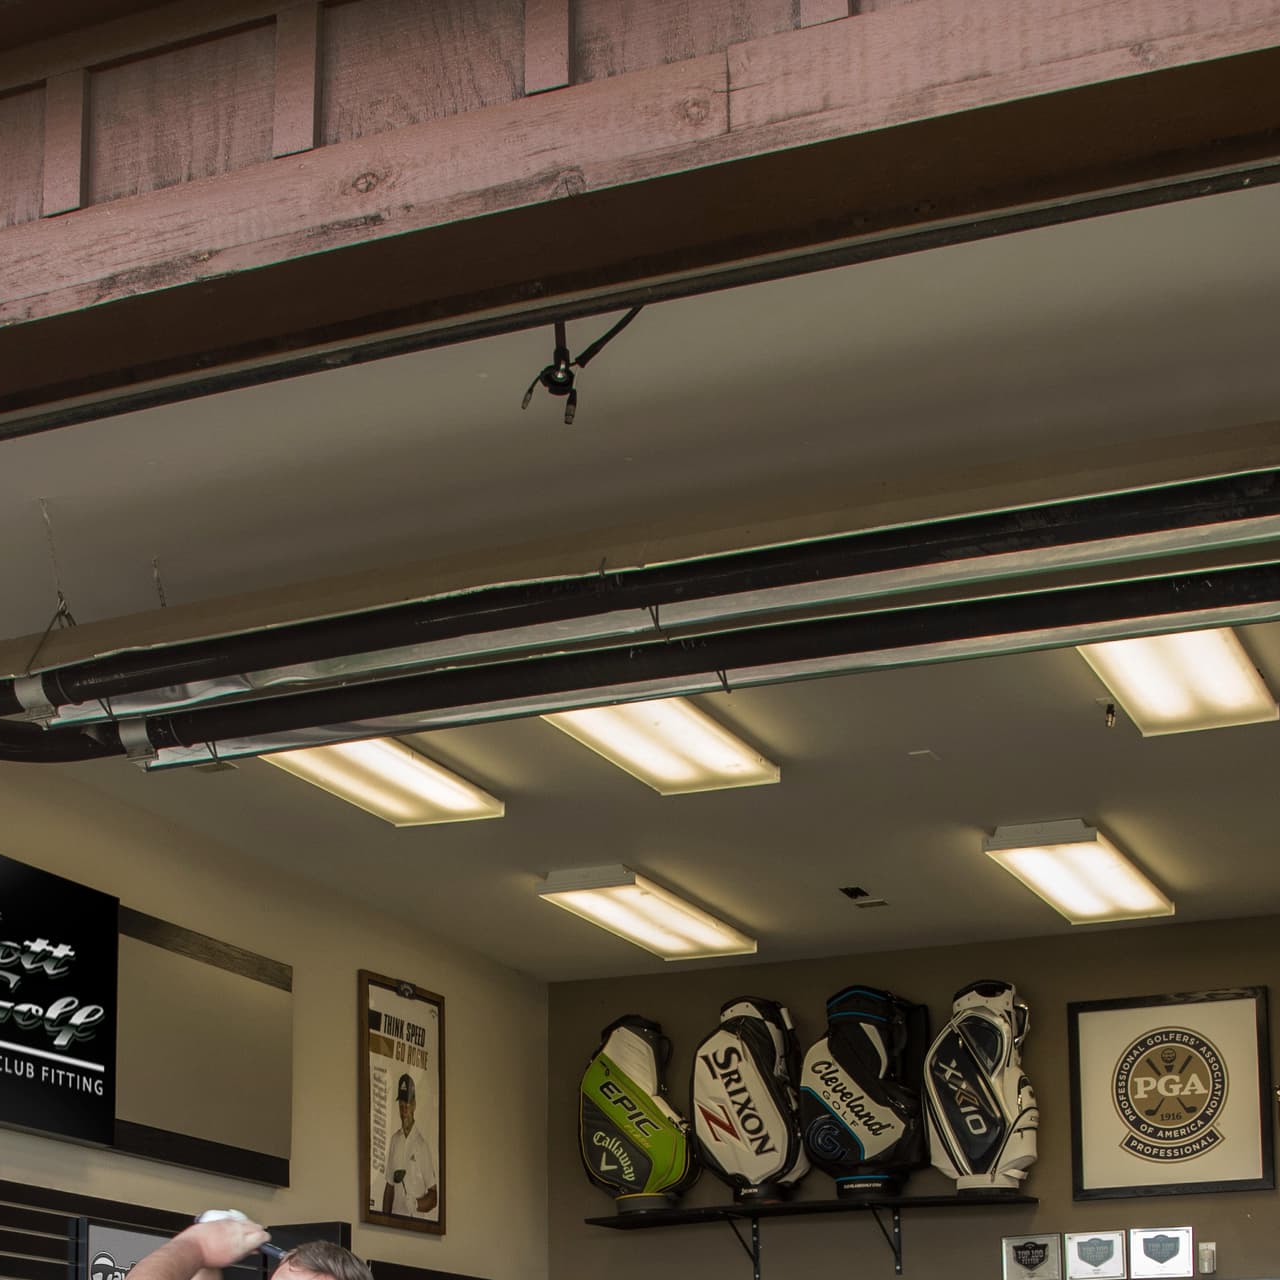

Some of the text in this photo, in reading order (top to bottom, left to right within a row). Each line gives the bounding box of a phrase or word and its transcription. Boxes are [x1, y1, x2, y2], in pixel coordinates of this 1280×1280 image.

[383, 1012, 426, 1049] THINK SPEED
[395, 1040, 429, 1072] GO ROGUE
[41, 1065, 104, 1096] FITTING
[1118, 1032, 1223, 1123] PROFESSIONAL GOLFERS' ASSOCIATION
[1133, 1072, 1209, 1099] PGA
[599, 1080, 662, 1139] EPIC
[700, 1046, 779, 1157] SRIXON
[811, 1059, 894, 1137] Cleveland
[822, 1090, 860, 1128] GOLF
[1139, 1118, 1206, 1140] OF AMERICA
[1159, 1112, 1183, 1122] 1916
[592, 1130, 636, 1183] Callaway
[1130, 1134, 1216, 1158] PROFESSIONAL
